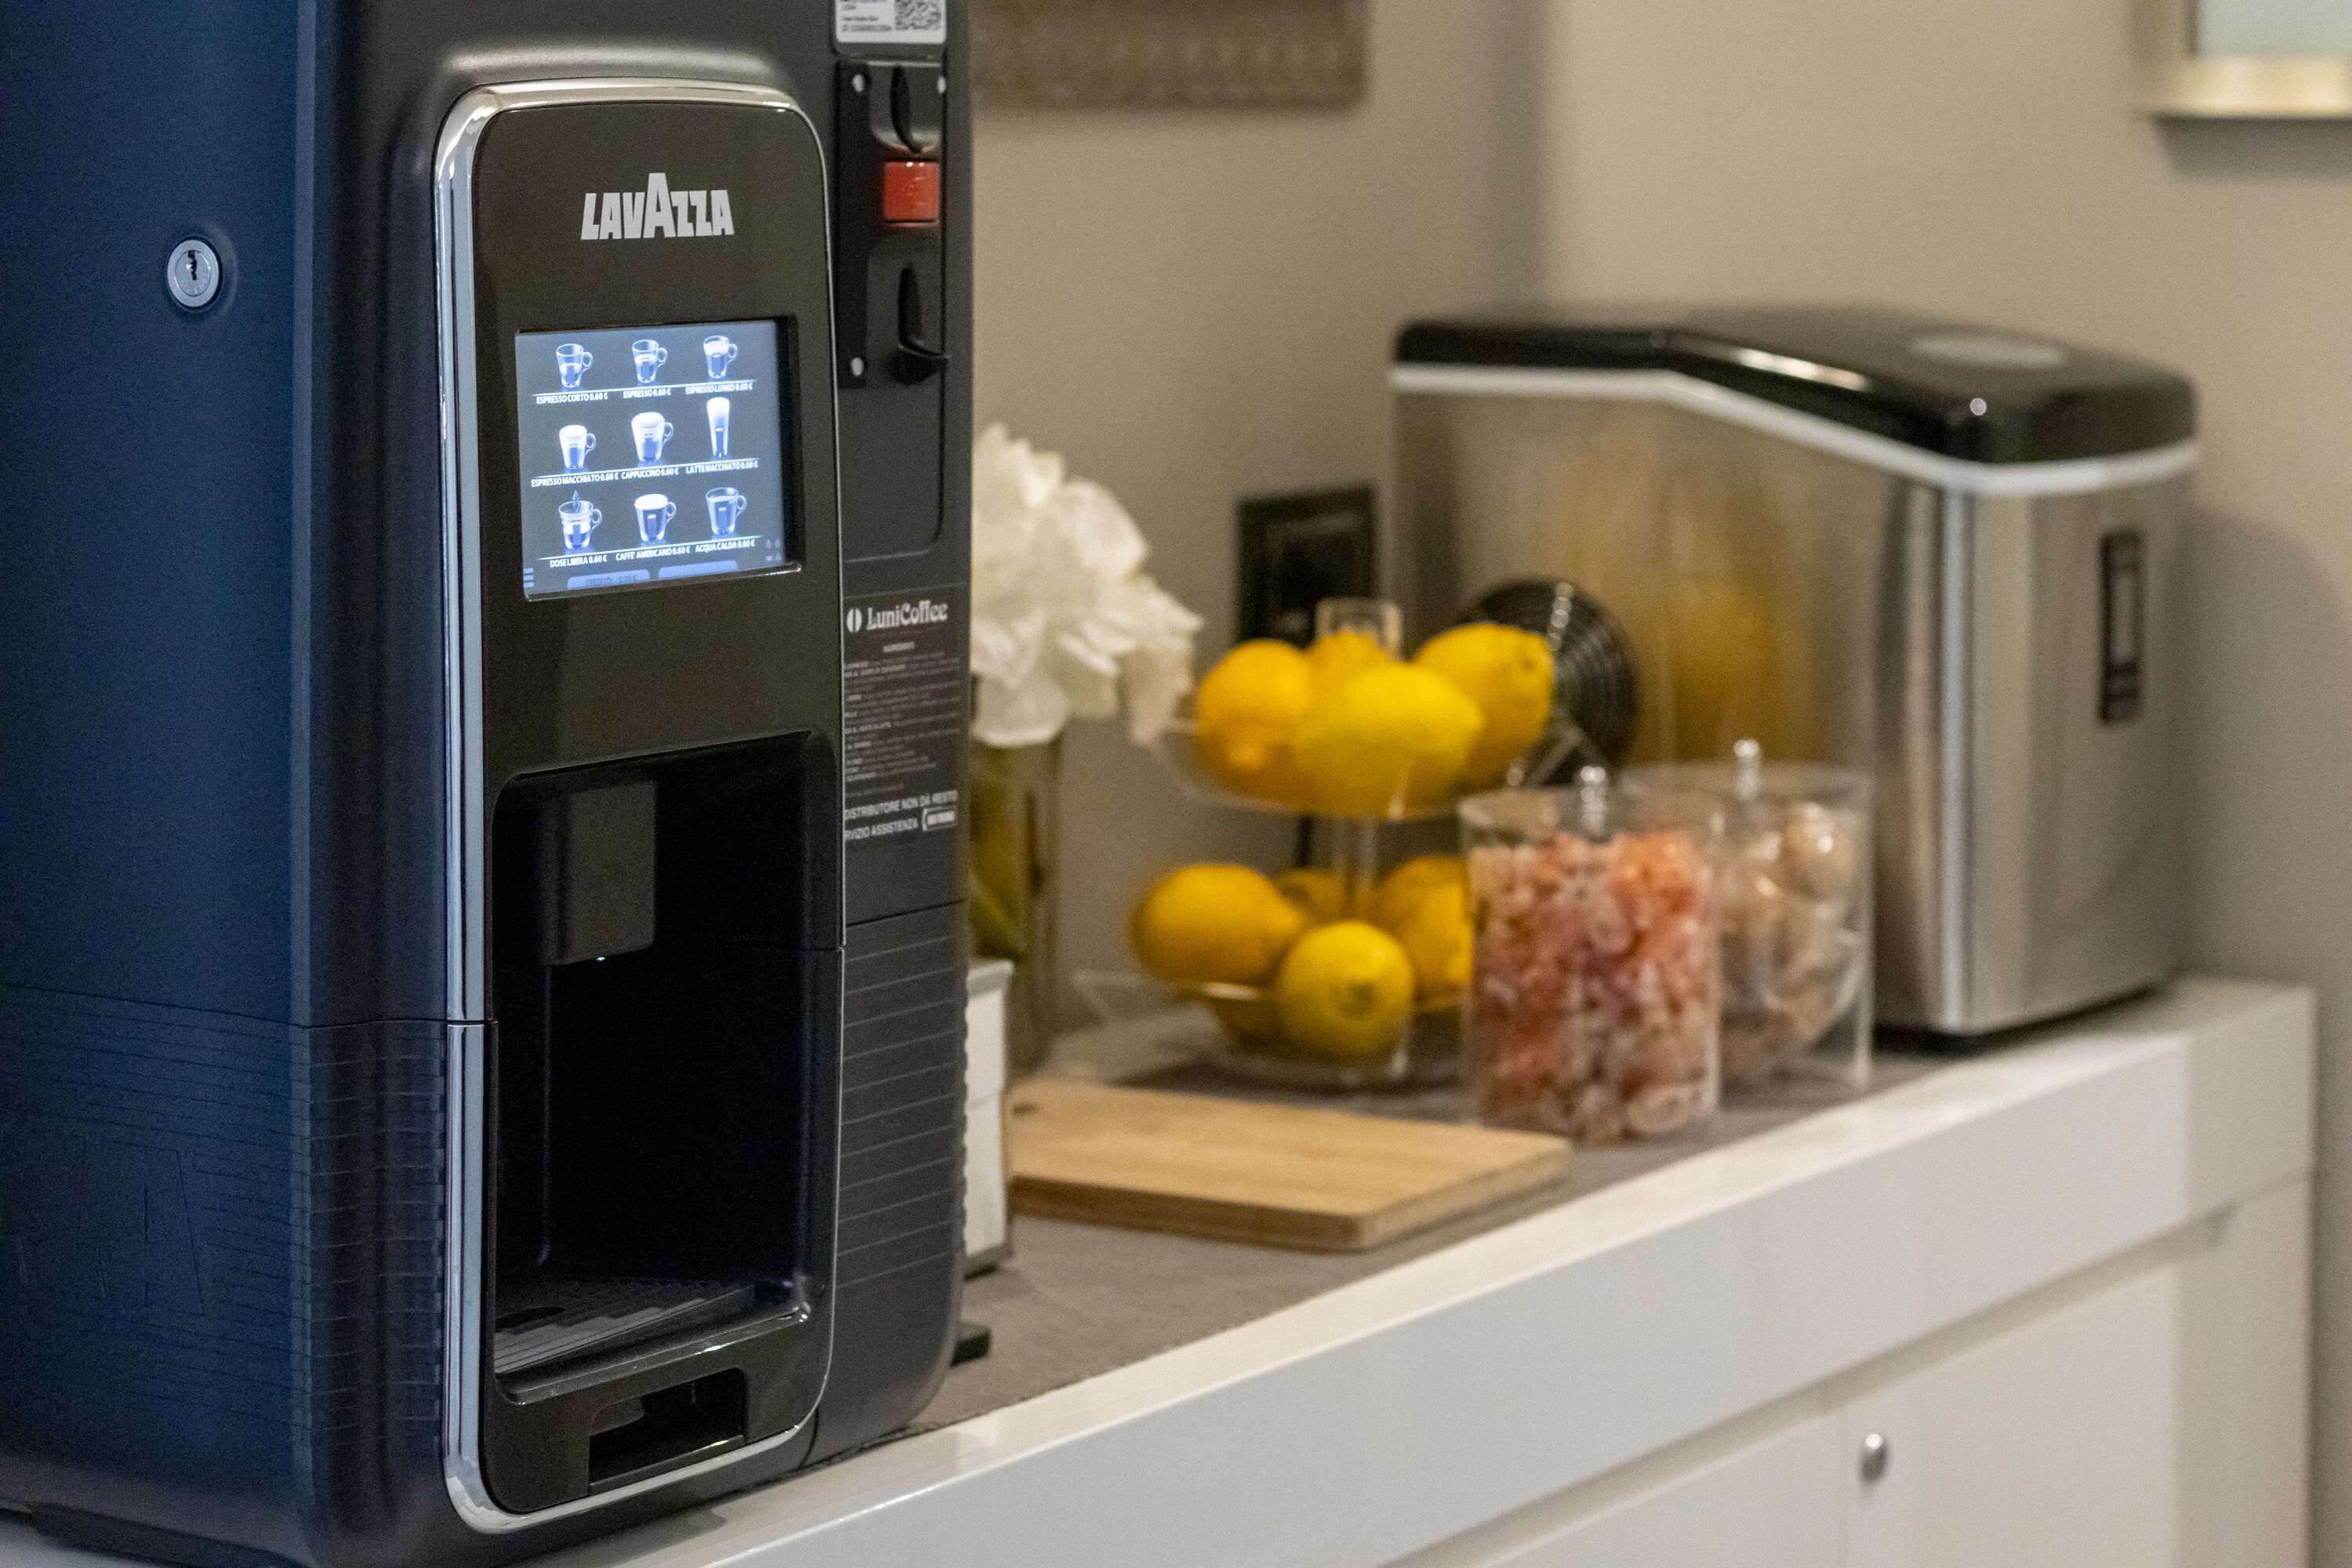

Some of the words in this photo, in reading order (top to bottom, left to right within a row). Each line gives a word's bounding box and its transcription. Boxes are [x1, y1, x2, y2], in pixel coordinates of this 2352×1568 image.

[581, 172, 734, 240] LAVAZZA
[623, 389, 652, 398] ESPRESSO
[653, 388, 666, 397] 0.60
[685, 385, 714, 394] ESPRESSO
[714, 383, 735, 393] LUNGO
[735, 383, 748, 391] 0.60
[536, 394, 567, 405] ESPRESSO
[568, 394, 589, 402] CORTO
[621, 469, 660, 480] CAPPUCCINO
[686, 465, 706, 474] LATTE
[706, 462, 740, 472] MACCHIATO
[532, 477, 561, 487] ESPRESSO
[562, 474, 600, 485] MACCHIATO
[601, 473, 613, 481] 0.60
[636, 548, 672, 559] AMERICANO
[672, 546, 685, 555] 0.60
[695, 543, 717, 554] ACQUA
[738, 539, 750, 548] 0.60
[550, 558, 566, 568] DOSE
[567, 557, 588, 566] LIBERA
[589, 555, 602, 564] 0.60
[866, 600, 948, 630] LuniCoffee
[844, 800, 899, 820] DISTRIBUTORE
[844, 826, 869, 841] RVIZIO
